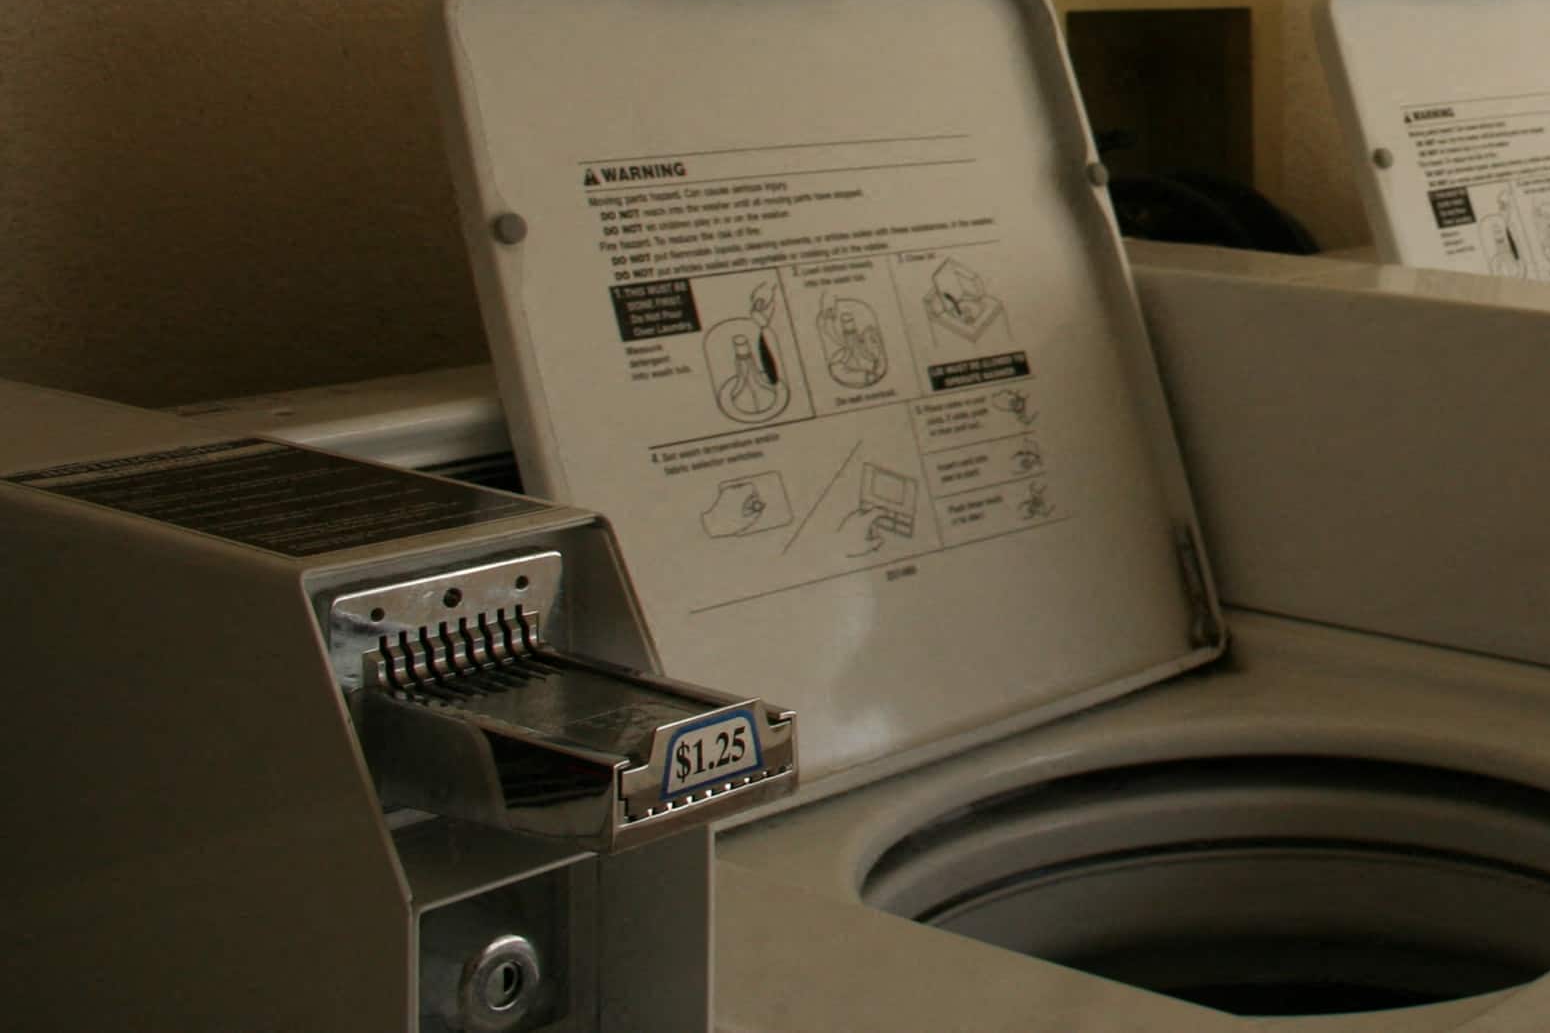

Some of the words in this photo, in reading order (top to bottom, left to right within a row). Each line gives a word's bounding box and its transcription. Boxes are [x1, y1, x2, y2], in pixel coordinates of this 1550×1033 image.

[601, 162, 687, 182] WARNING
[600, 211, 616, 221] DO
[619, 208, 639, 220] NOT
[603, 226, 619, 237] DO
[621, 223, 642, 234] NOT
[611, 255, 627, 266] DO
[629, 252, 650, 264] NOT
[614, 270, 630, 281] DO
[633, 267, 653, 278] NOT
[676, 726, 746, 782] $1.25
